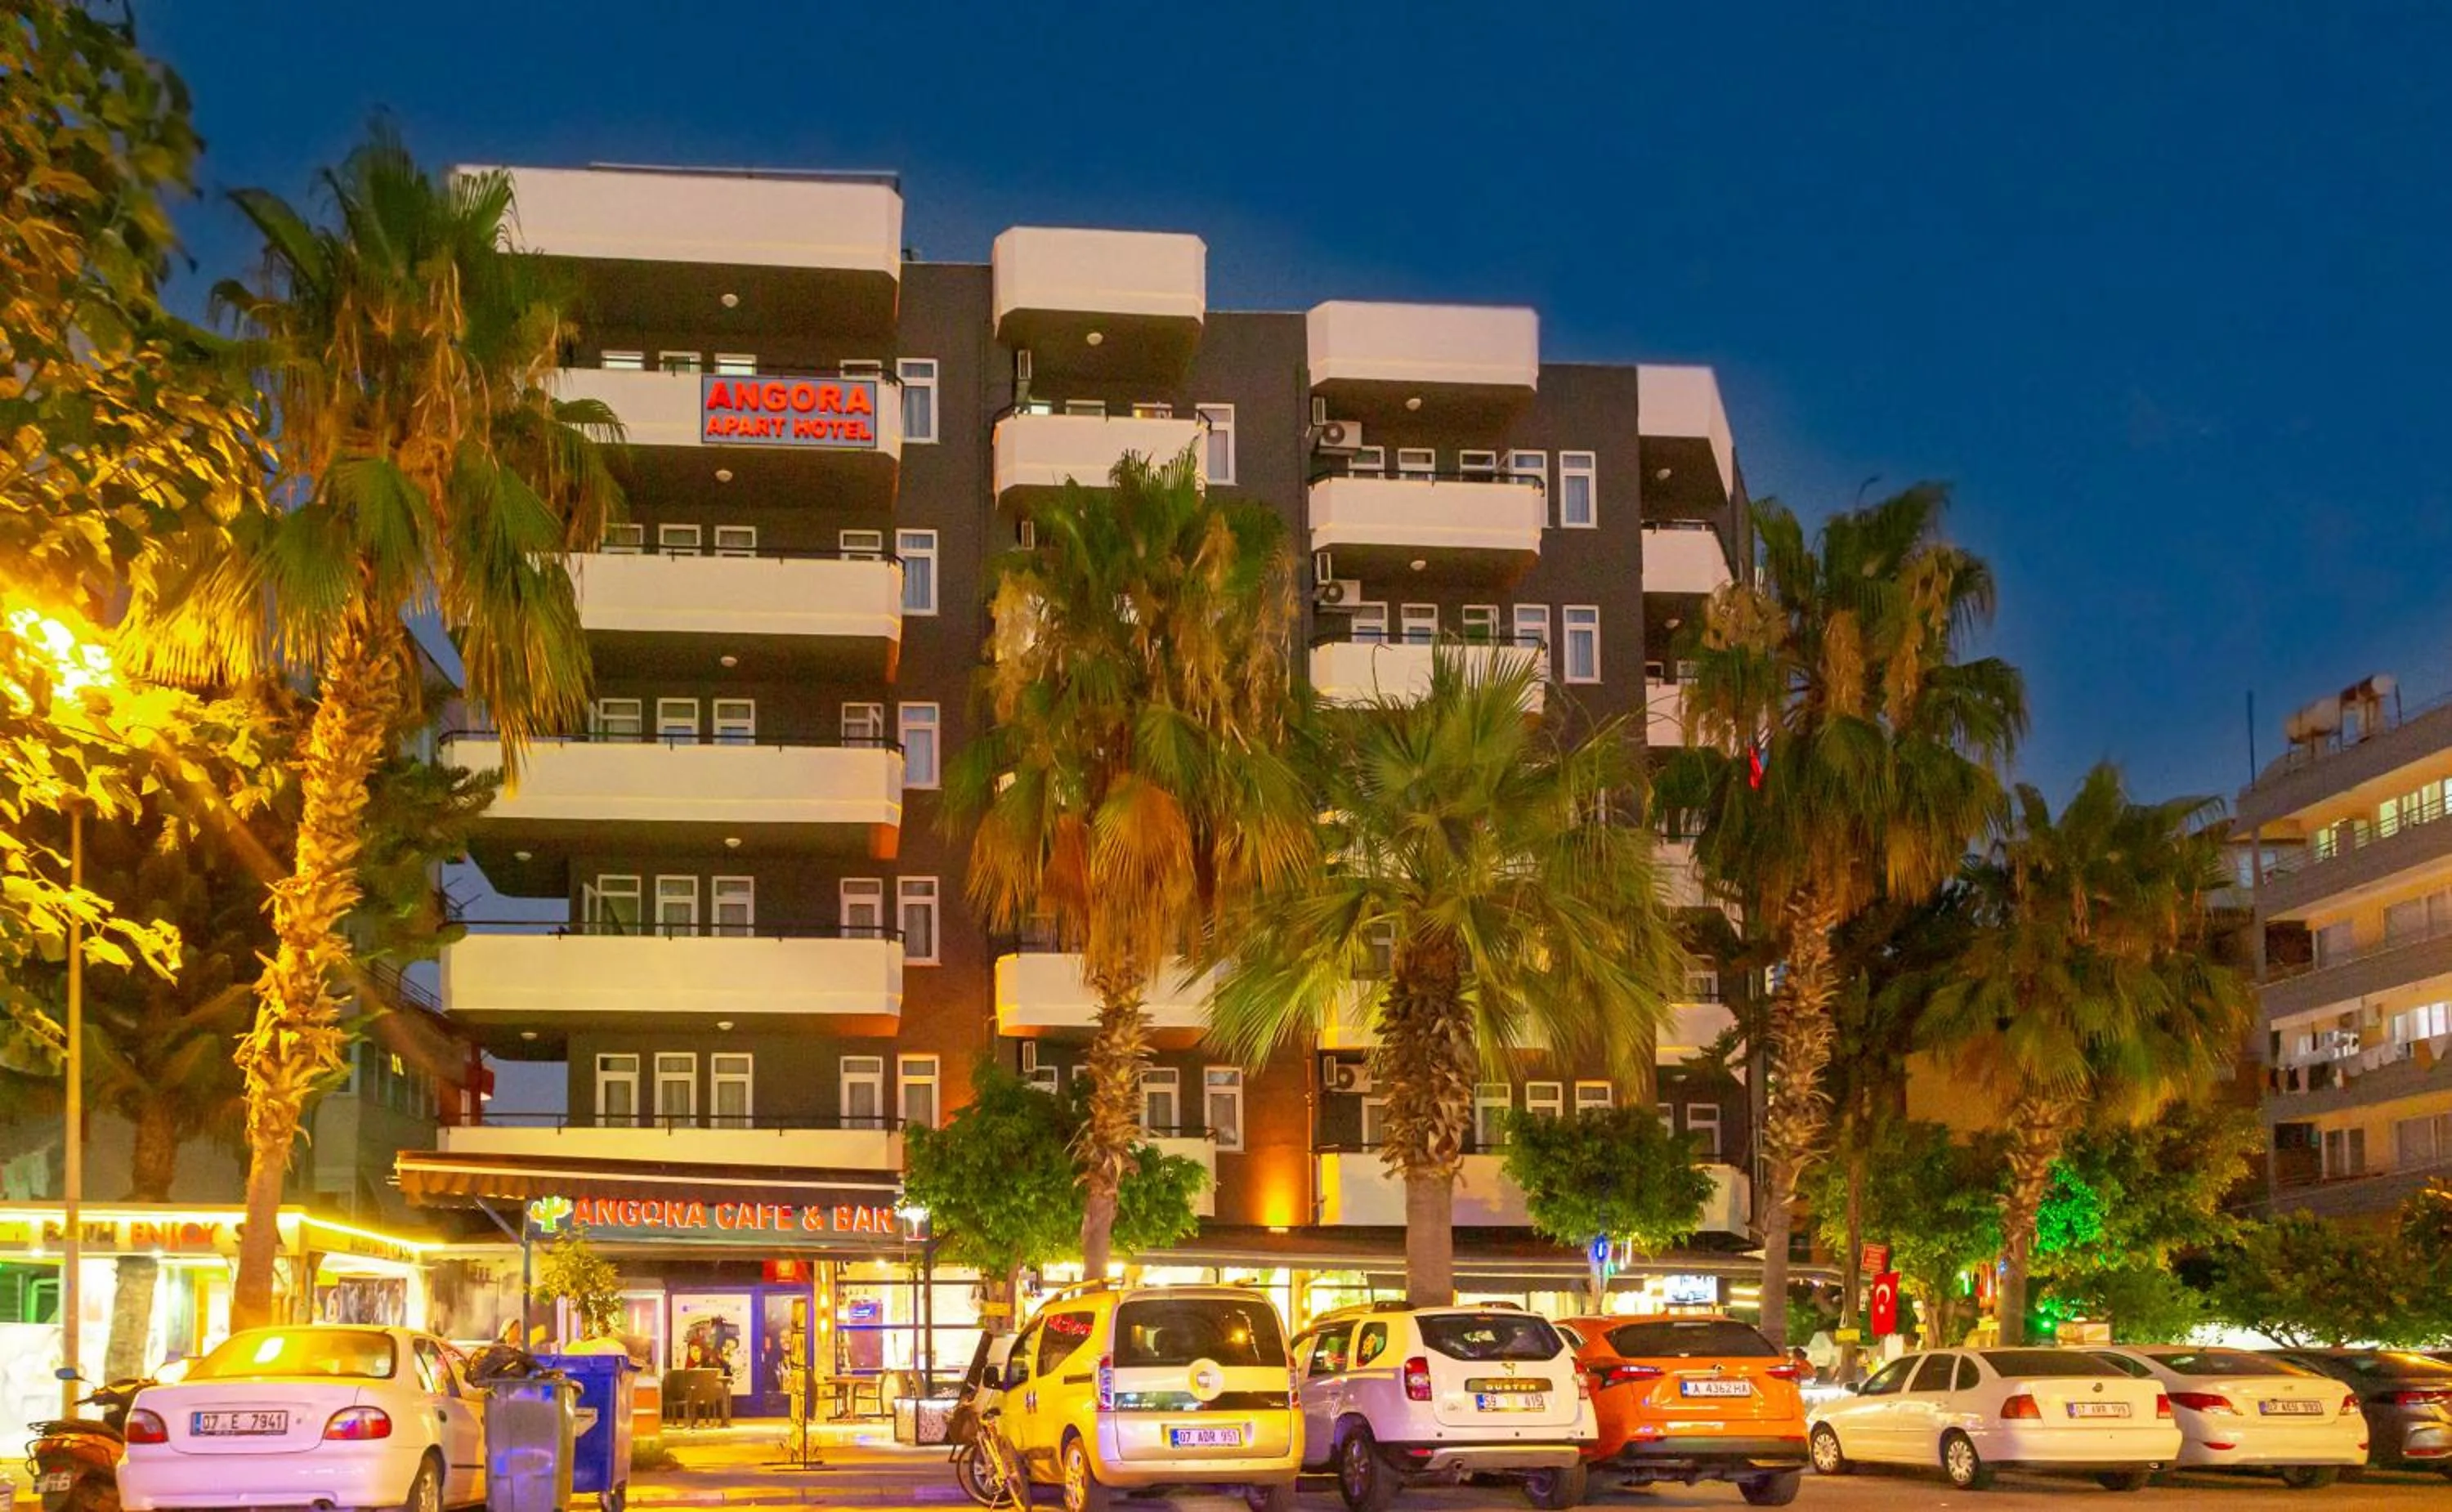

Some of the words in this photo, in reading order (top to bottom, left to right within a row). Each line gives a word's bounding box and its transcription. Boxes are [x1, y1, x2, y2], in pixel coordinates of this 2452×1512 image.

[706, 381, 872, 415] ANGORA
[706, 414, 785, 438] APART
[794, 418, 872, 441] HOTEL
[573, 1197, 708, 1229] ANGORA
[715, 1202, 794, 1231] CAFE
[801, 1206, 825, 1232] &
[833, 1205, 894, 1234] BAR
[1693, 1383, 1701, 1394] A
[203, 1414, 218, 1429] 07
[230, 1413, 239, 1429] E
[251, 1413, 283, 1430] 7941
[1179, 1430, 1191, 1443] 07
